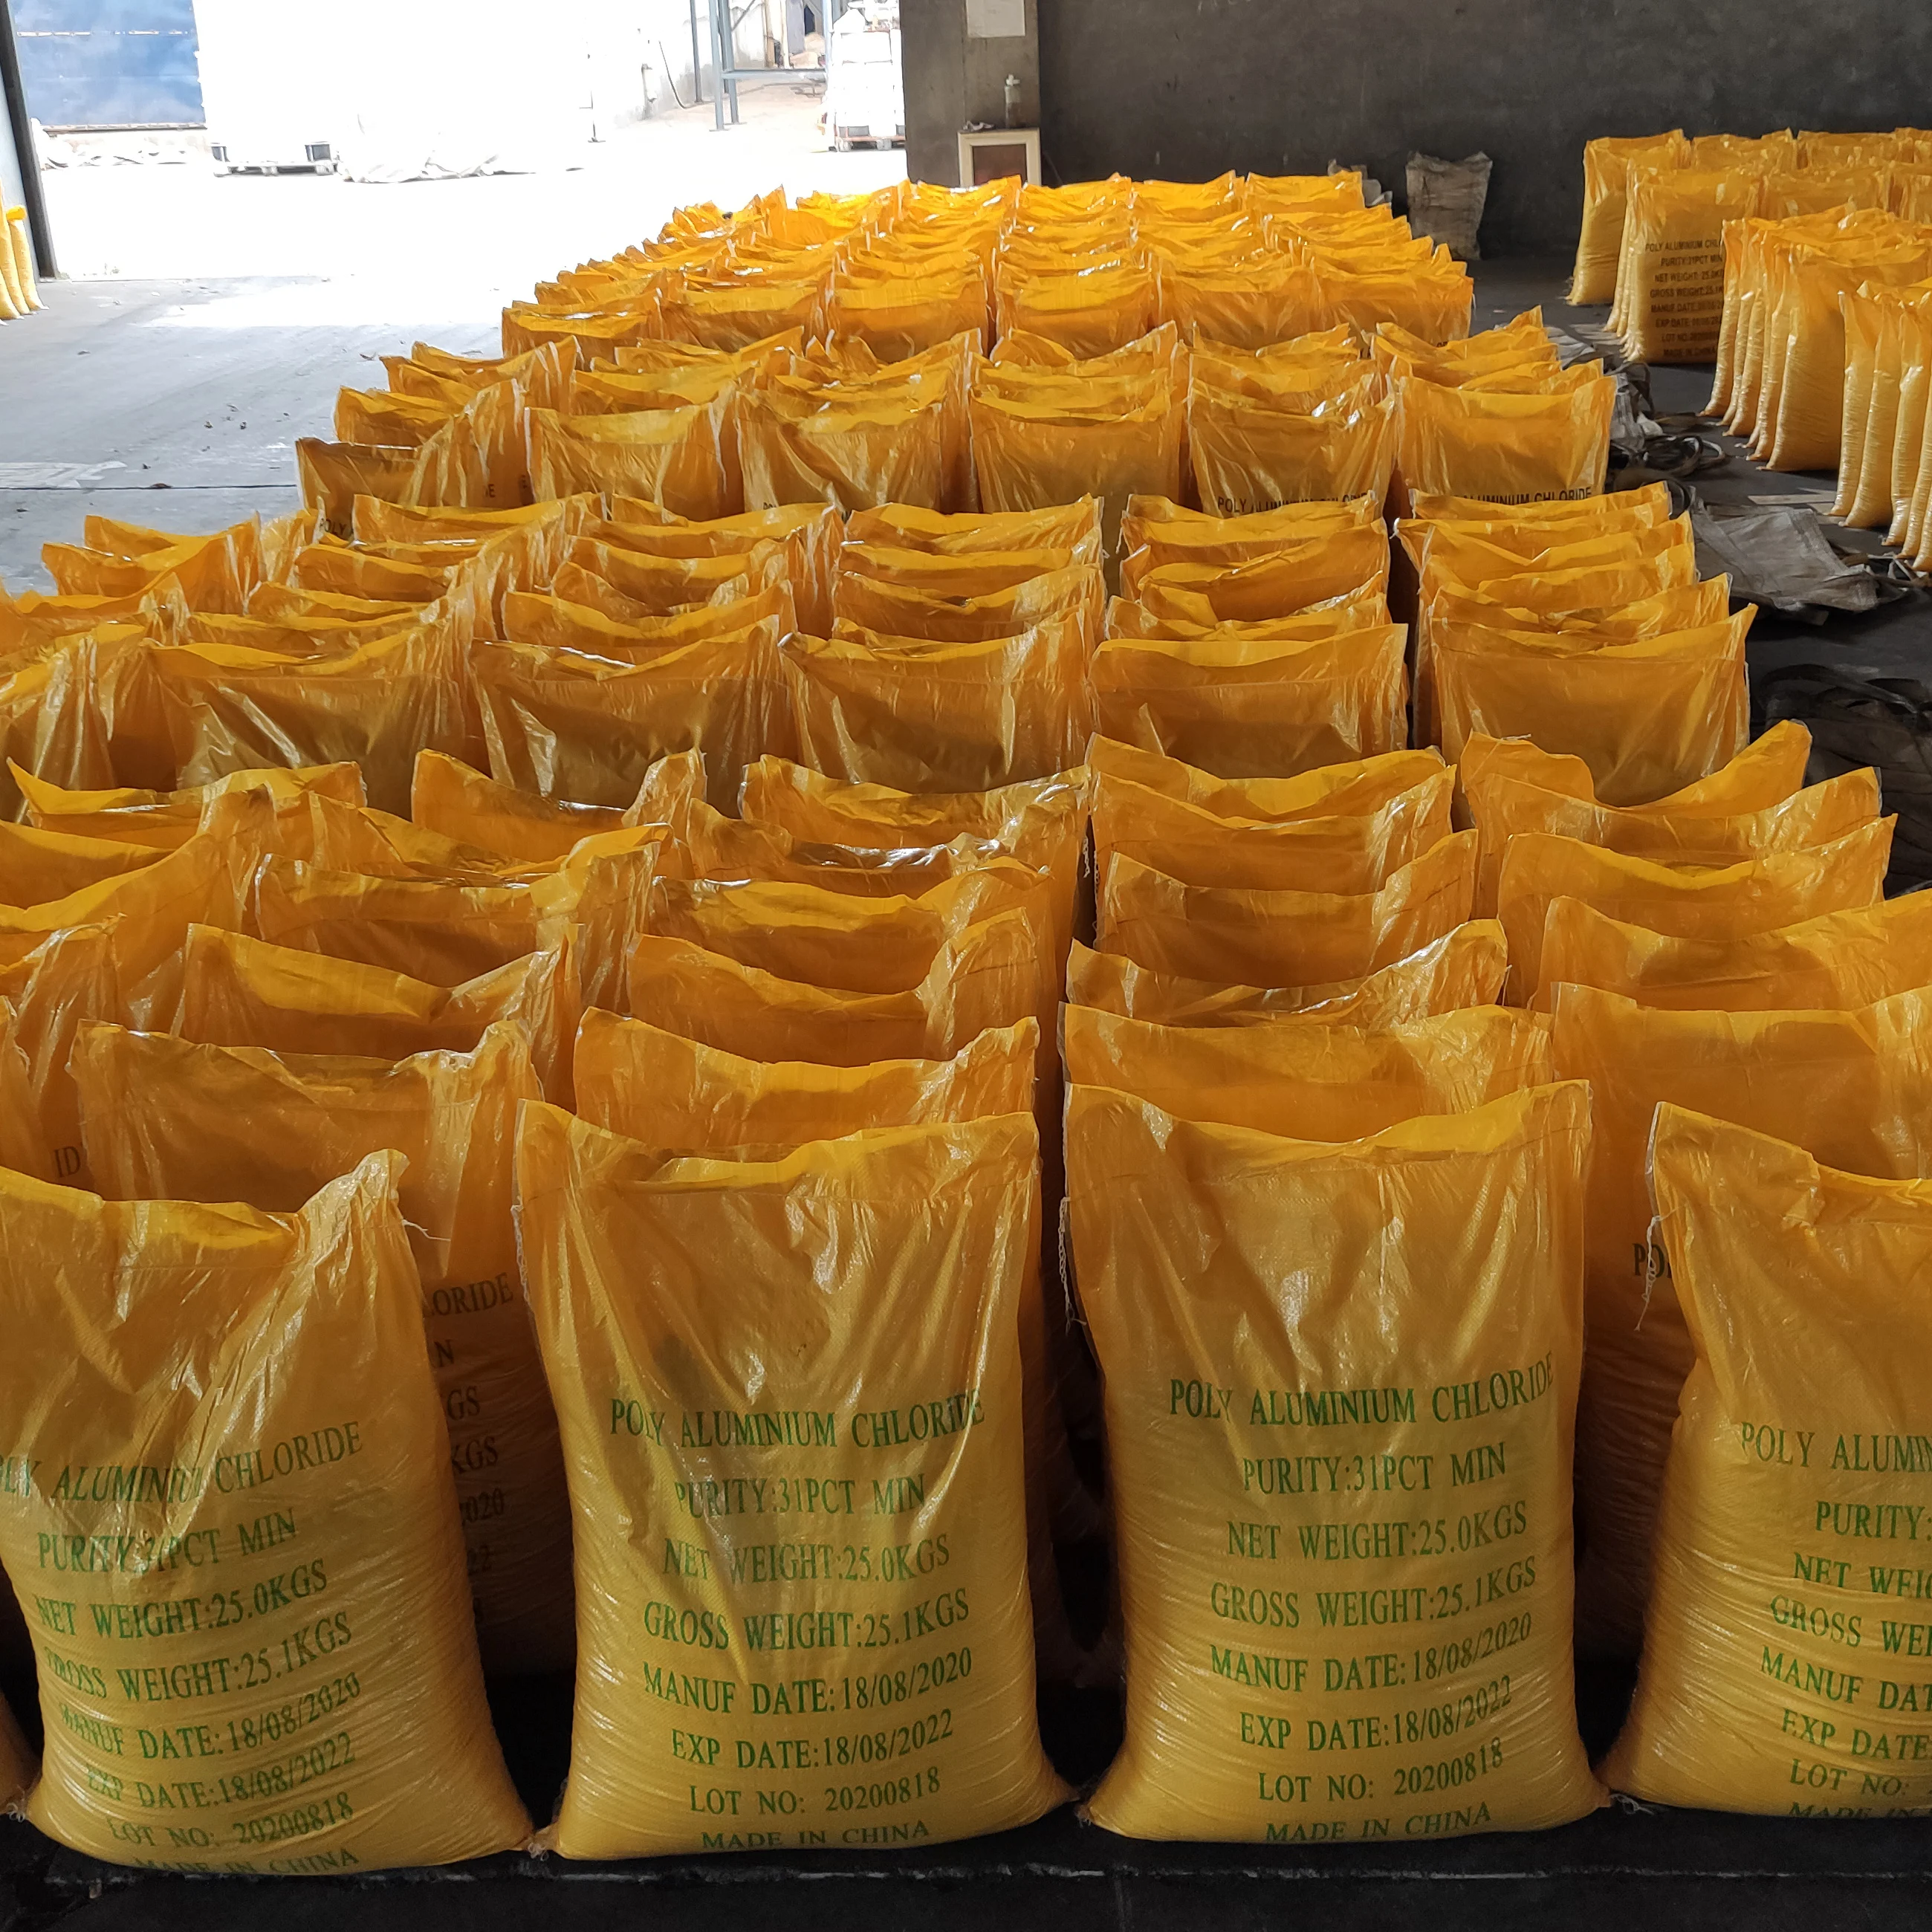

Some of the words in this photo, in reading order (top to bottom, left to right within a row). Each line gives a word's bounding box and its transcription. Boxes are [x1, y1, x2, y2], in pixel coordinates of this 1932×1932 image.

[1654, 273, 1668, 282] NET
[1218, 496, 1247, 513] POLY
[424, 1271, 513, 1317] ORIDE
[1170, 1378, 1233, 1423] POLY
[1250, 1387, 1417, 1427] ALUMINIUM
[1432, 1350, 1555, 1423] CHLORIDE
[610, 1398, 666, 1447] POLY
[681, 1410, 837, 1448] ALUMINIUM
[1741, 1422, 1815, 1468] POLY
[215, 1421, 363, 1494] CHLORIDE
[1242, 1454, 1434, 1495] PURITY:31PCT
[1450, 1442, 1505, 1487] MIN
[675, 1477, 856, 1519] PURITY:31PCT
[872, 1473, 925, 1515] MIN
[238, 1507, 296, 1556] MIN
[1227, 1520, 1281, 1560] NET
[1297, 1500, 1527, 1560] WEIGHT:25.0KGS
[664, 1537, 710, 1581] NET
[730, 1534, 950, 1584] WEIGHT:25.0KGS
[1795, 1552, 1852, 1588] NET
[33, 1593, 77, 1636] NET
[89, 1557, 327, 1639] WEIGHT:25.0KGS
[1211, 1581, 1300, 1628] GROSS
[1315, 1555, 1536, 1628] WEIGHT:25.1KGS
[644, 1601, 729, 1650] GROSS
[742, 1587, 969, 1652] WEIGHT:25.1KGS
[1770, 1594, 1862, 1648] GROSS
[116, 1611, 352, 1702] WEIGHT:25.1KGS
[1210, 1644, 1309, 1692] MANUF
[1761, 1644, 1864, 1704] MANUF
[643, 1661, 736, 1714] MANUF
[59, 1702, 124, 1756] MANUF
[672, 1728, 721, 1766] EXP
[1239, 1711, 1291, 1750] EXP
[1781, 1707, 1836, 1748] EXP
[690, 1785, 742, 1815] LOT
[756, 1790, 806, 1815] NO:
[824, 1766, 941, 1812] 20200818
[1259, 1771, 1312, 1803] LOT
[1327, 1773, 1374, 1802] NO:
[1393, 1737, 1503, 1796] 20200818
[1790, 1758, 1848, 1791] LOT
[107, 1818, 156, 1847] LOT
[165, 1826, 221, 1849] NO:
[233, 1792, 354, 1844] 20200818
[701, 1831, 783, 1850] MADE
[798, 1830, 826, 1844] IN
[841, 1820, 929, 1844] CHINA
[1265, 1821, 1346, 1841] MADE
[1361, 1818, 1390, 1838] IN
[1404, 1801, 1491, 1835] CHINA
